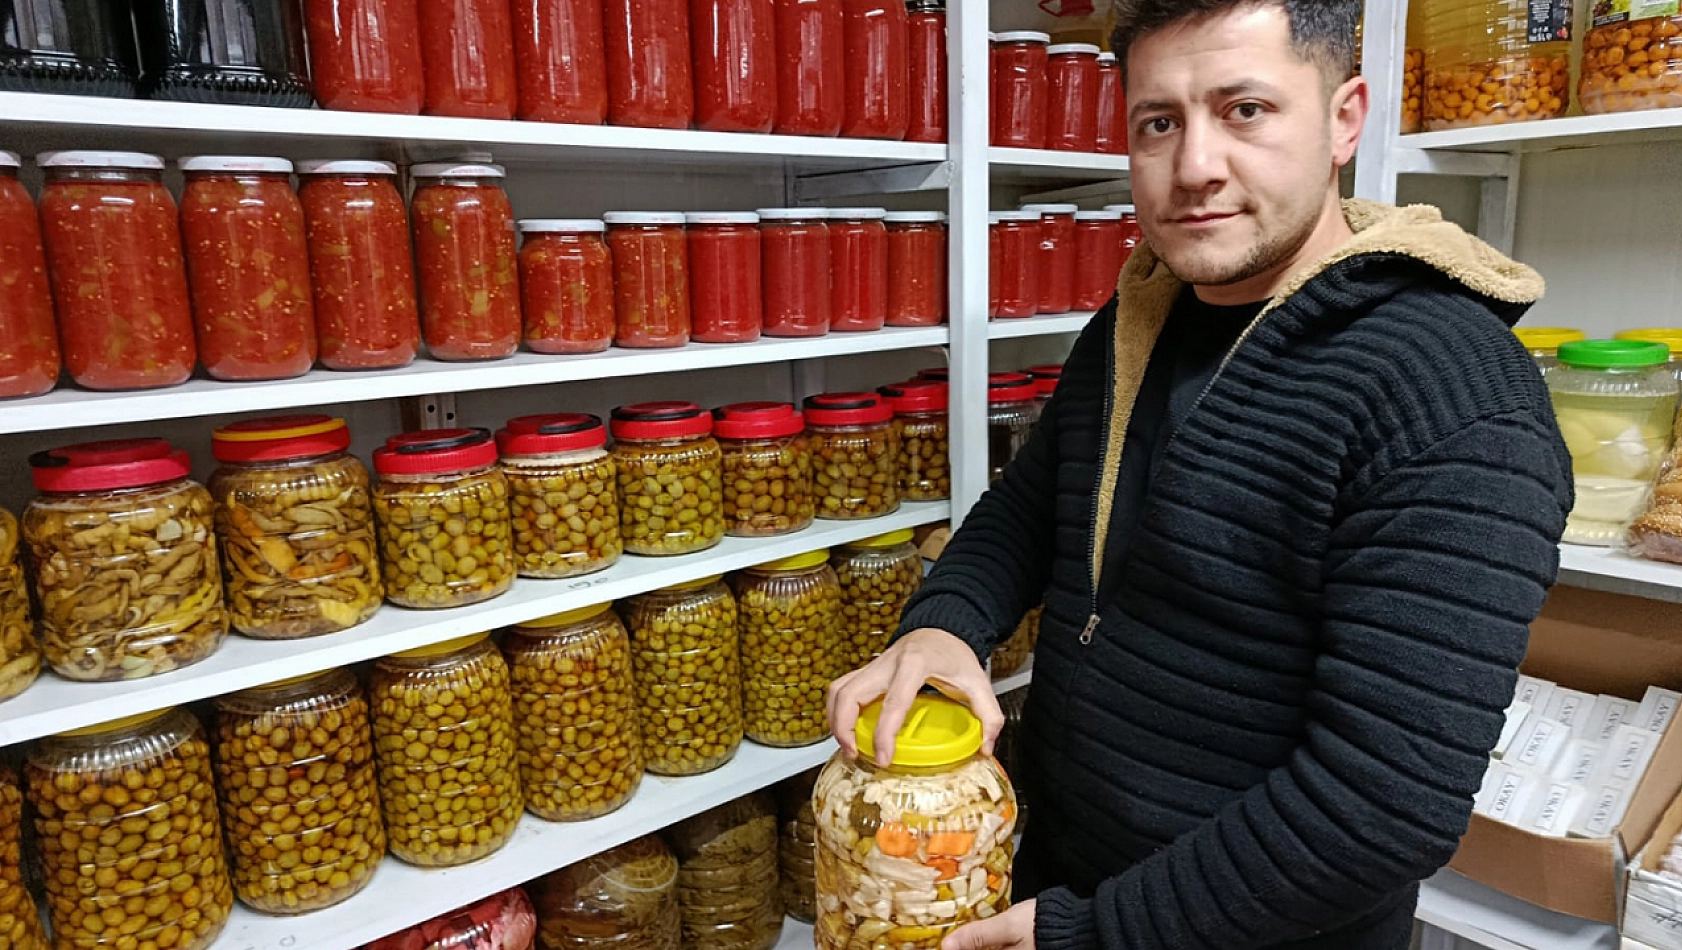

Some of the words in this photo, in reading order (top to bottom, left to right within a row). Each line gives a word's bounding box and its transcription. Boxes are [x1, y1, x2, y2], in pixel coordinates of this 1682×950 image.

[1601, 709, 1619, 740] OKAY
[1649, 702, 1669, 731] OKAY
[1525, 729, 1546, 757] OKAY
[1617, 741, 1639, 768] OKAY
[1495, 781, 1515, 811] OKAY
[1541, 792, 1562, 818] OKAY
[1593, 795, 1614, 821] OKAY
